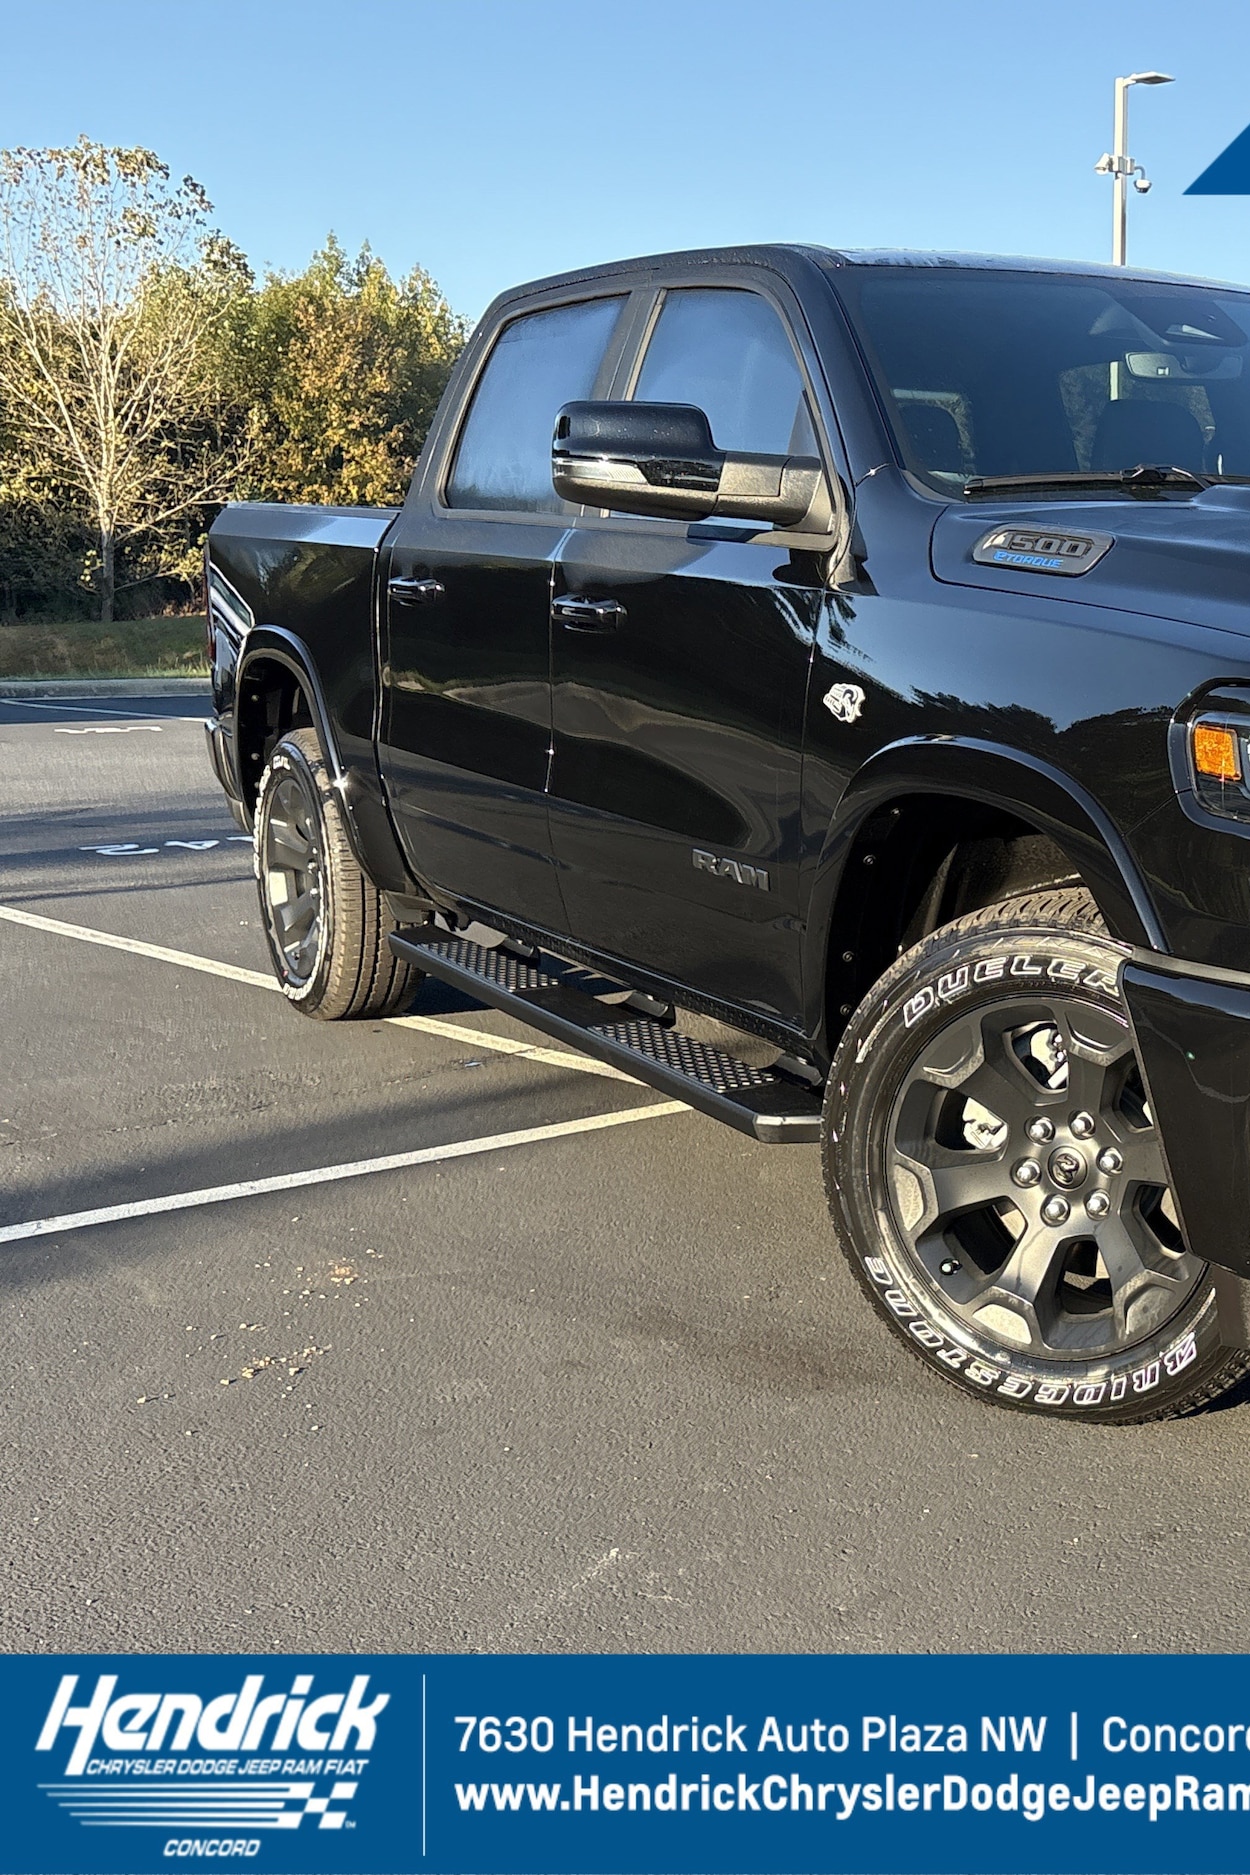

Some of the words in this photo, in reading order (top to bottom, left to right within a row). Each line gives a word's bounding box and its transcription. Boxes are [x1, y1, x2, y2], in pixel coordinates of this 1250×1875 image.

[991, 530, 1088, 557] 1500
[692, 848, 771, 892] RAM
[902, 955, 1120, 1028] DUELER
[864, 1255, 1197, 1405] BRIDGESTONE
